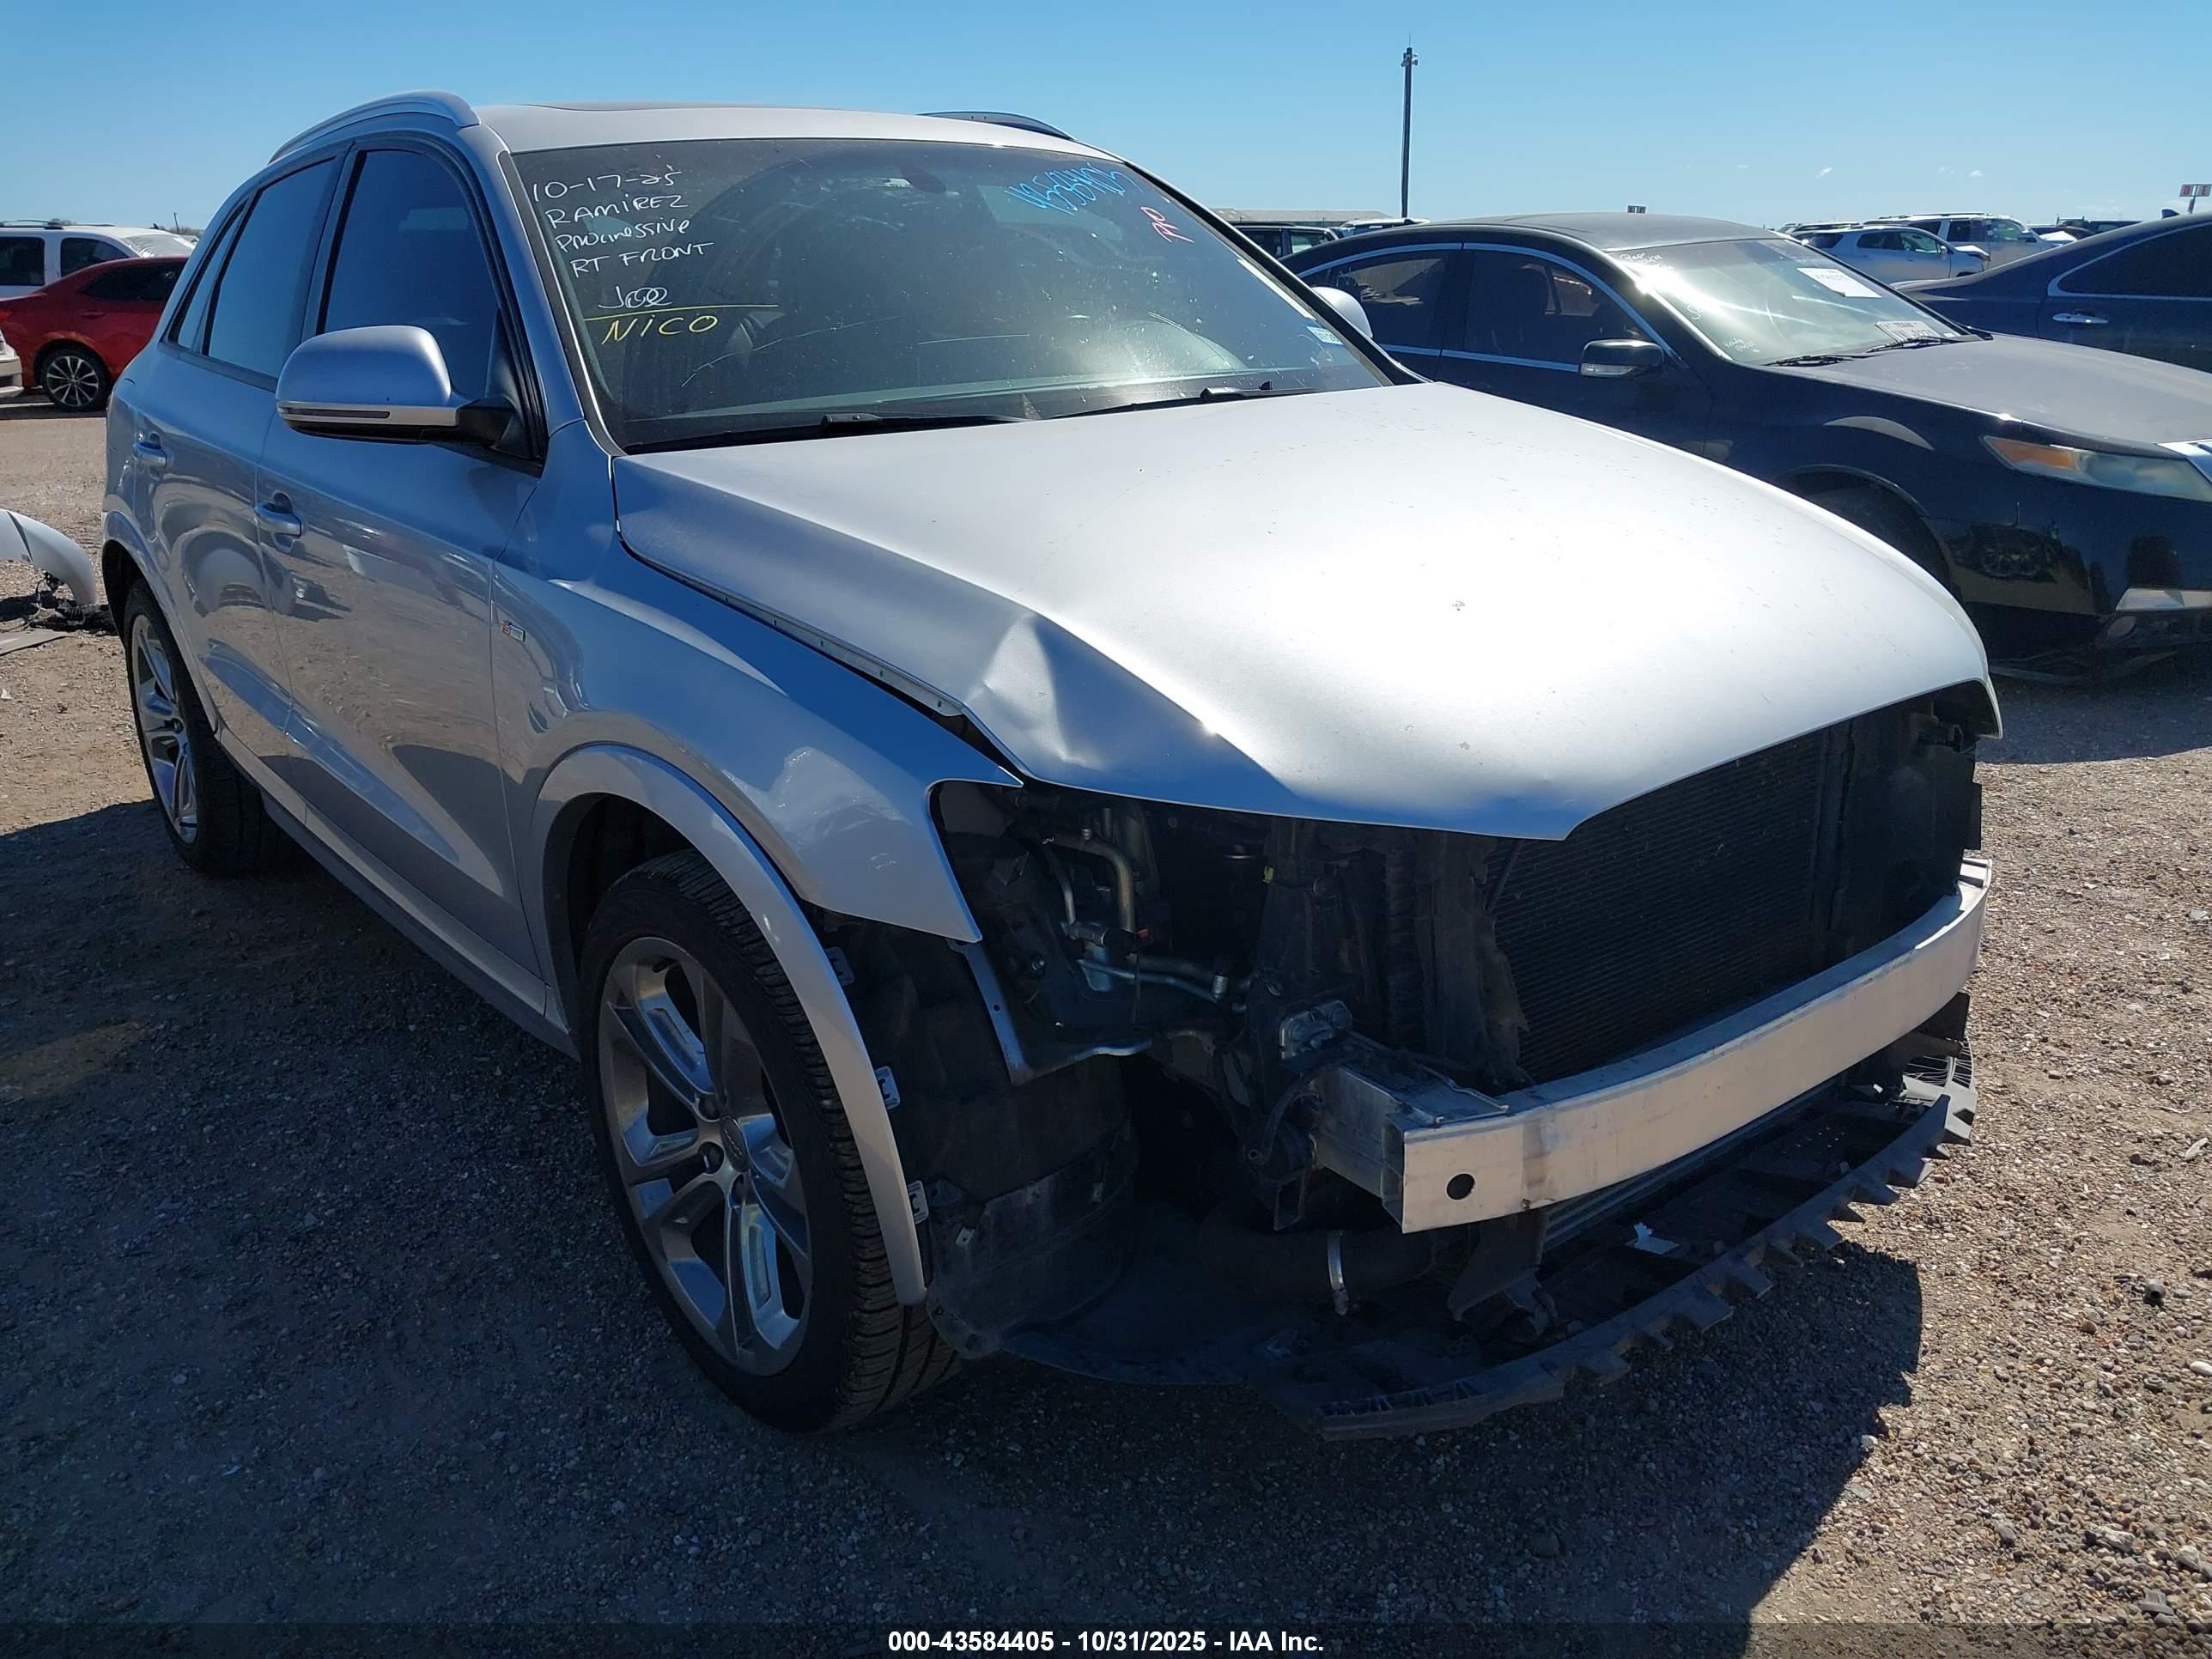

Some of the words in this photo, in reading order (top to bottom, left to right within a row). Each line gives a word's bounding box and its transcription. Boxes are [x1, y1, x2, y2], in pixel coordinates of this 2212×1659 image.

[533, 171, 684, 202] 10-17-25
[570, 255, 611, 278] RT
[618, 242, 714, 266] FRONT
